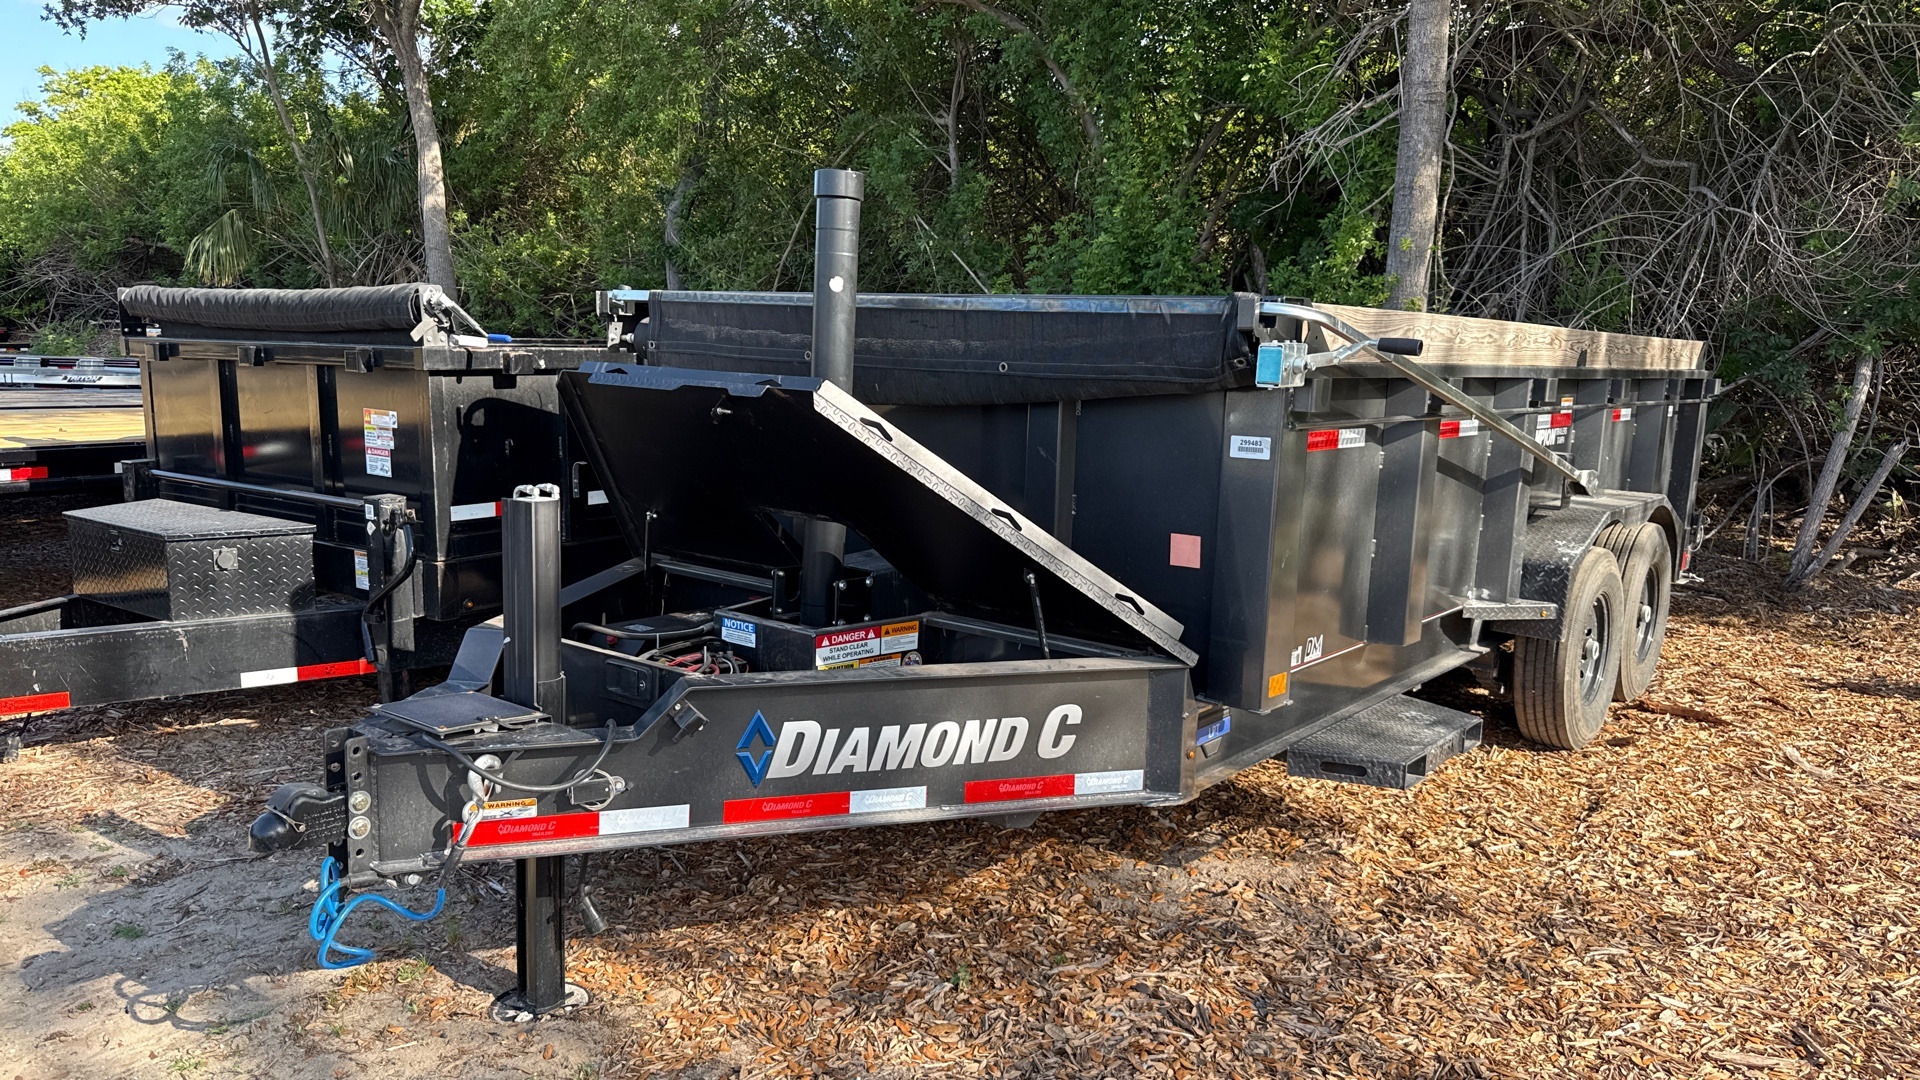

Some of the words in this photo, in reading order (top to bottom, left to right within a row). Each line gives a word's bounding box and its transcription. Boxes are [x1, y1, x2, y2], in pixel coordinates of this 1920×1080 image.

[1240, 439, 1263, 447] 299483
[724, 618, 754, 633] NOTICE
[891, 625, 917, 634] WARNING
[831, 631, 865, 644] DANGER
[829, 645, 848, 654] STAND
[849, 641, 868, 651] CLEAR
[823, 653, 841, 662] WHILE
[842, 648, 874, 658] OPERATING
[1208, 723, 1220, 738] LPT
[766, 718, 1029, 779] DIAMOND
[1037, 704, 1083, 759] C
[1002, 782, 1037, 793] DIAMOND
[1037, 781, 1045, 790] C
[1091, 776, 1122, 786] DIAMOND
[1122, 775, 1130, 784] C
[868, 793, 904, 804] DIAMOND
[904, 791, 913, 801] C
[488, 801, 527, 809] WARNING
[765, 801, 805, 812] DIAMOND
[805, 799, 814, 809] C
[503, 823, 547, 834] DIAMOND
[547, 821, 557, 831] C
